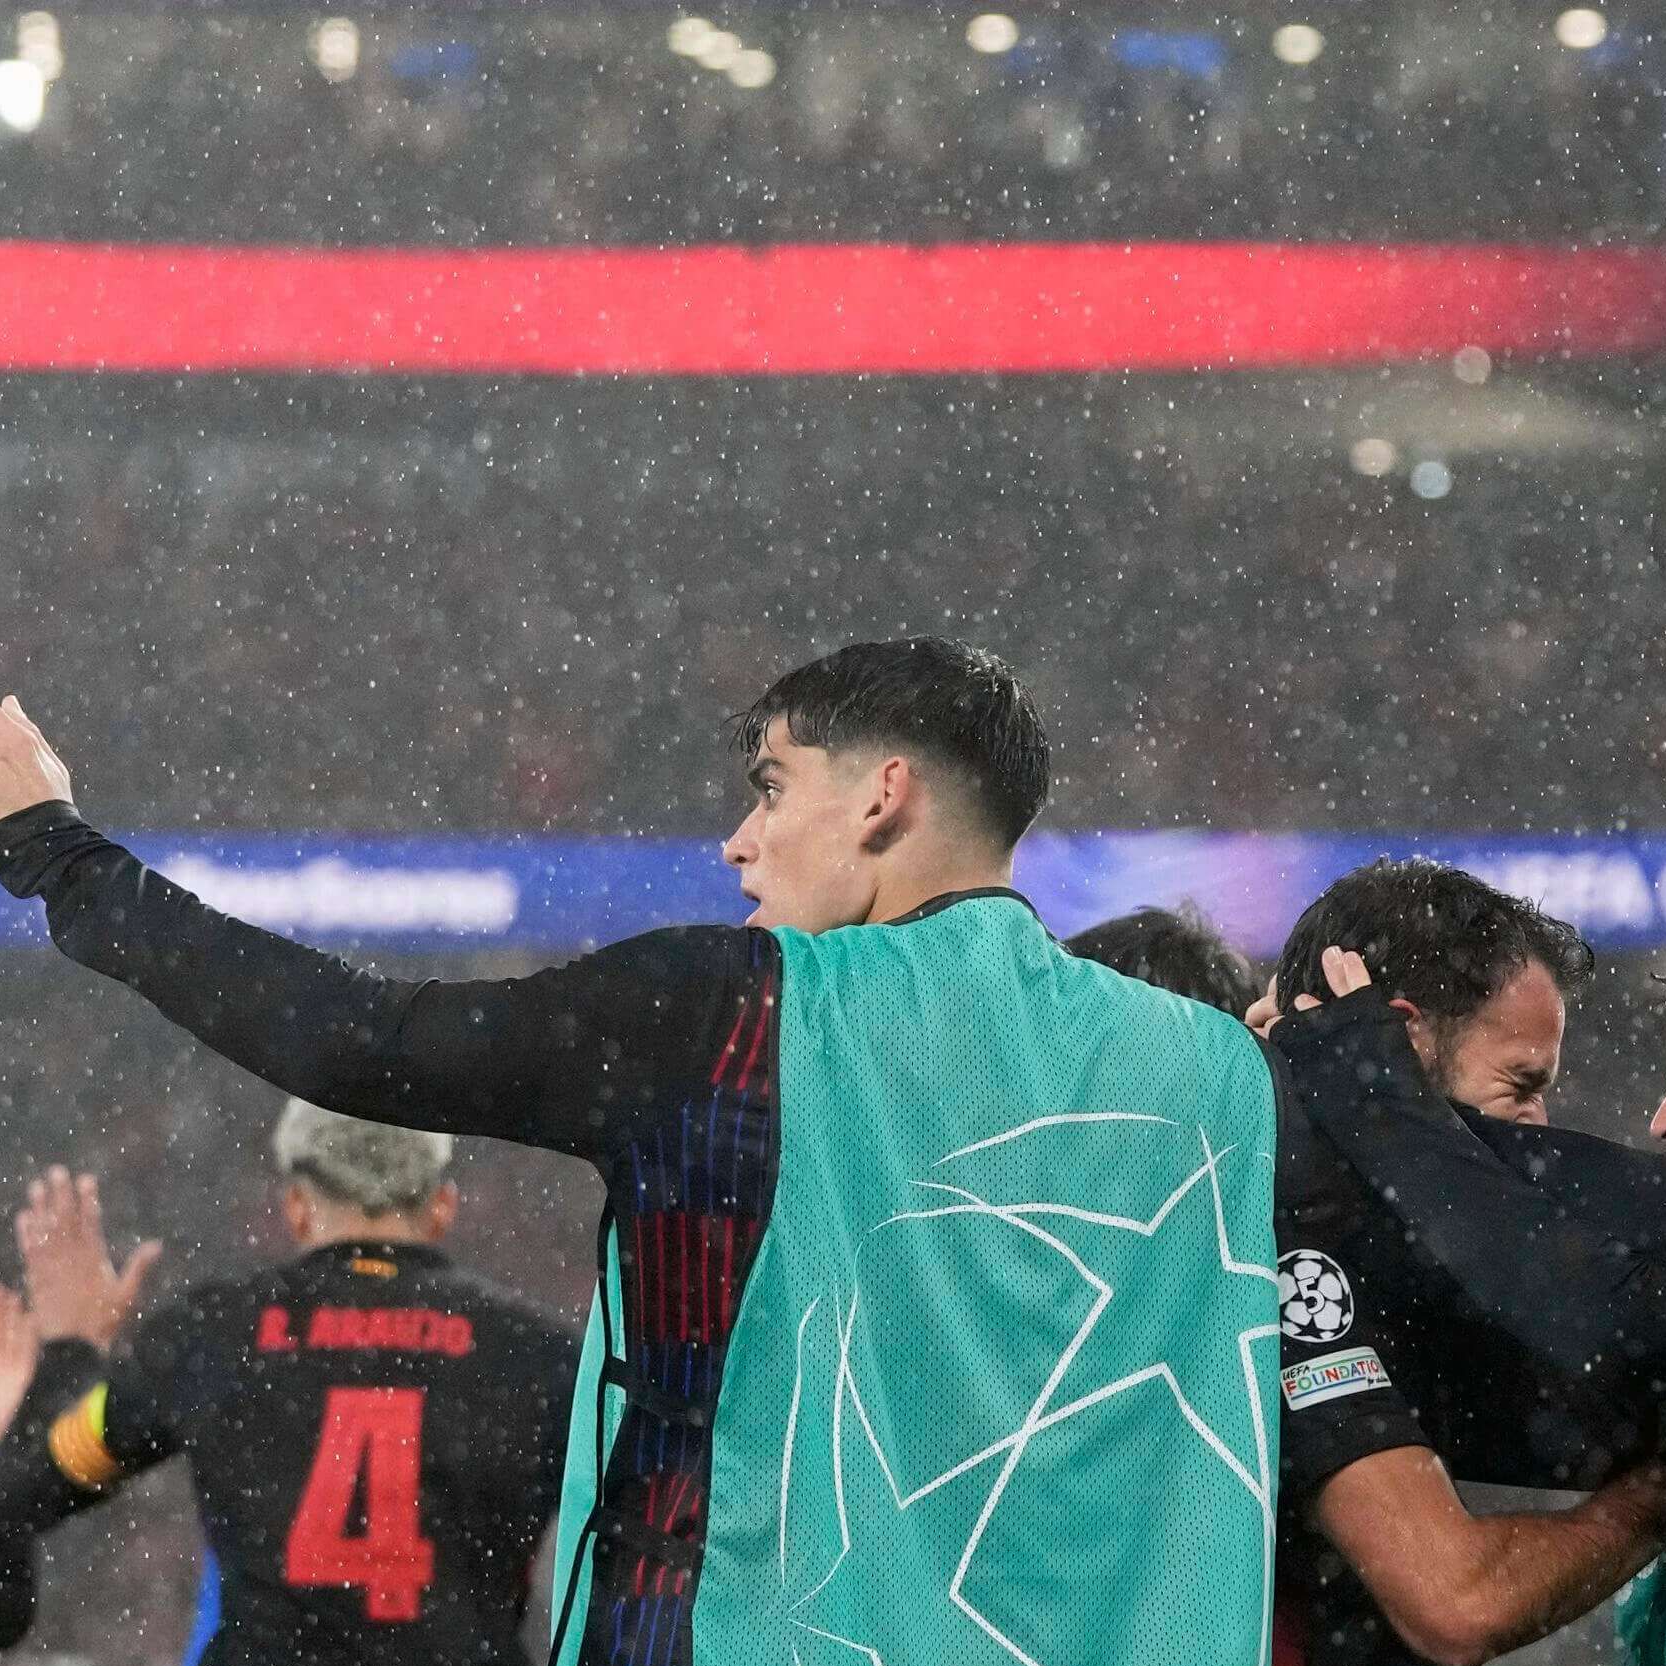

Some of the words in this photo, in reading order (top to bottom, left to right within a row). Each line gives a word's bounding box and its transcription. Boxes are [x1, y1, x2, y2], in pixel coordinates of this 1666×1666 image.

[1296, 1275, 1326, 1315] 5
[1282, 1365, 1312, 1381] UEFA
[286, 1386, 434, 1623] 4
